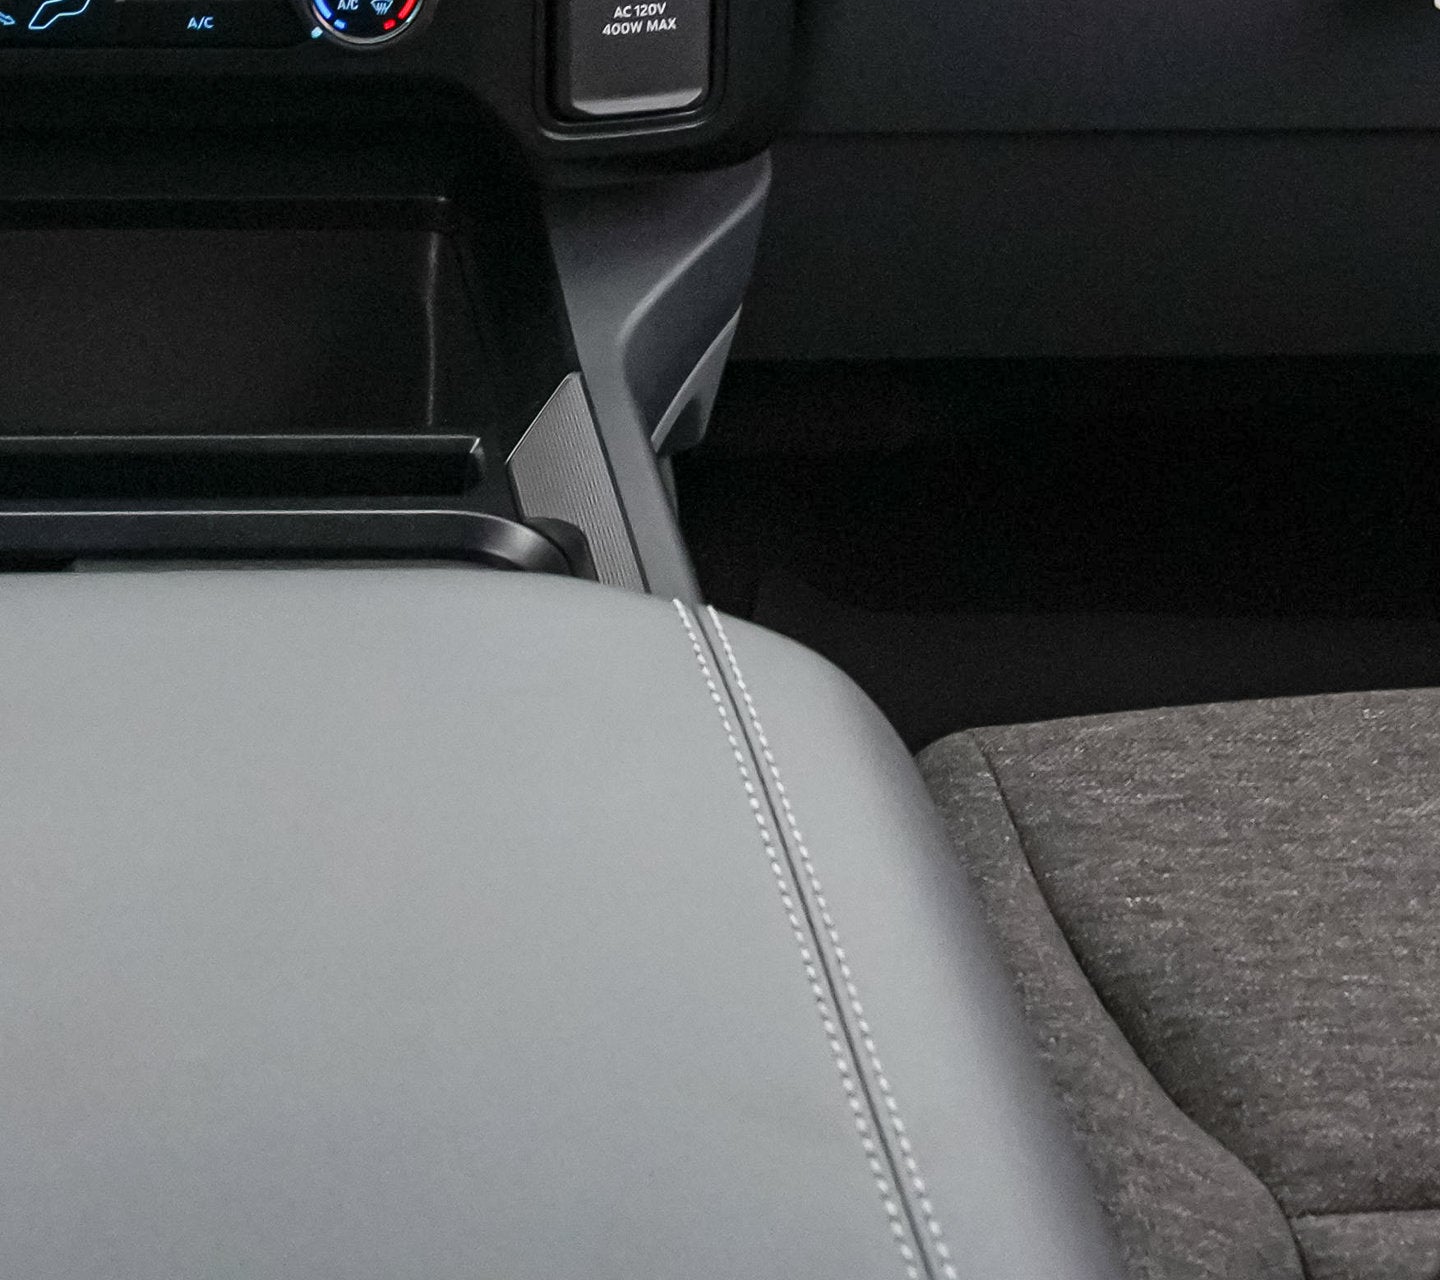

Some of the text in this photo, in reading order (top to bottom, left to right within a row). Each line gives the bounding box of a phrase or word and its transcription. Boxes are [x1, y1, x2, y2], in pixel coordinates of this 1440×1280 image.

[613, 2, 667, 19] AC 120V
[187, 15, 214, 30] A/C
[602, 17, 677, 36] 400W MAX
